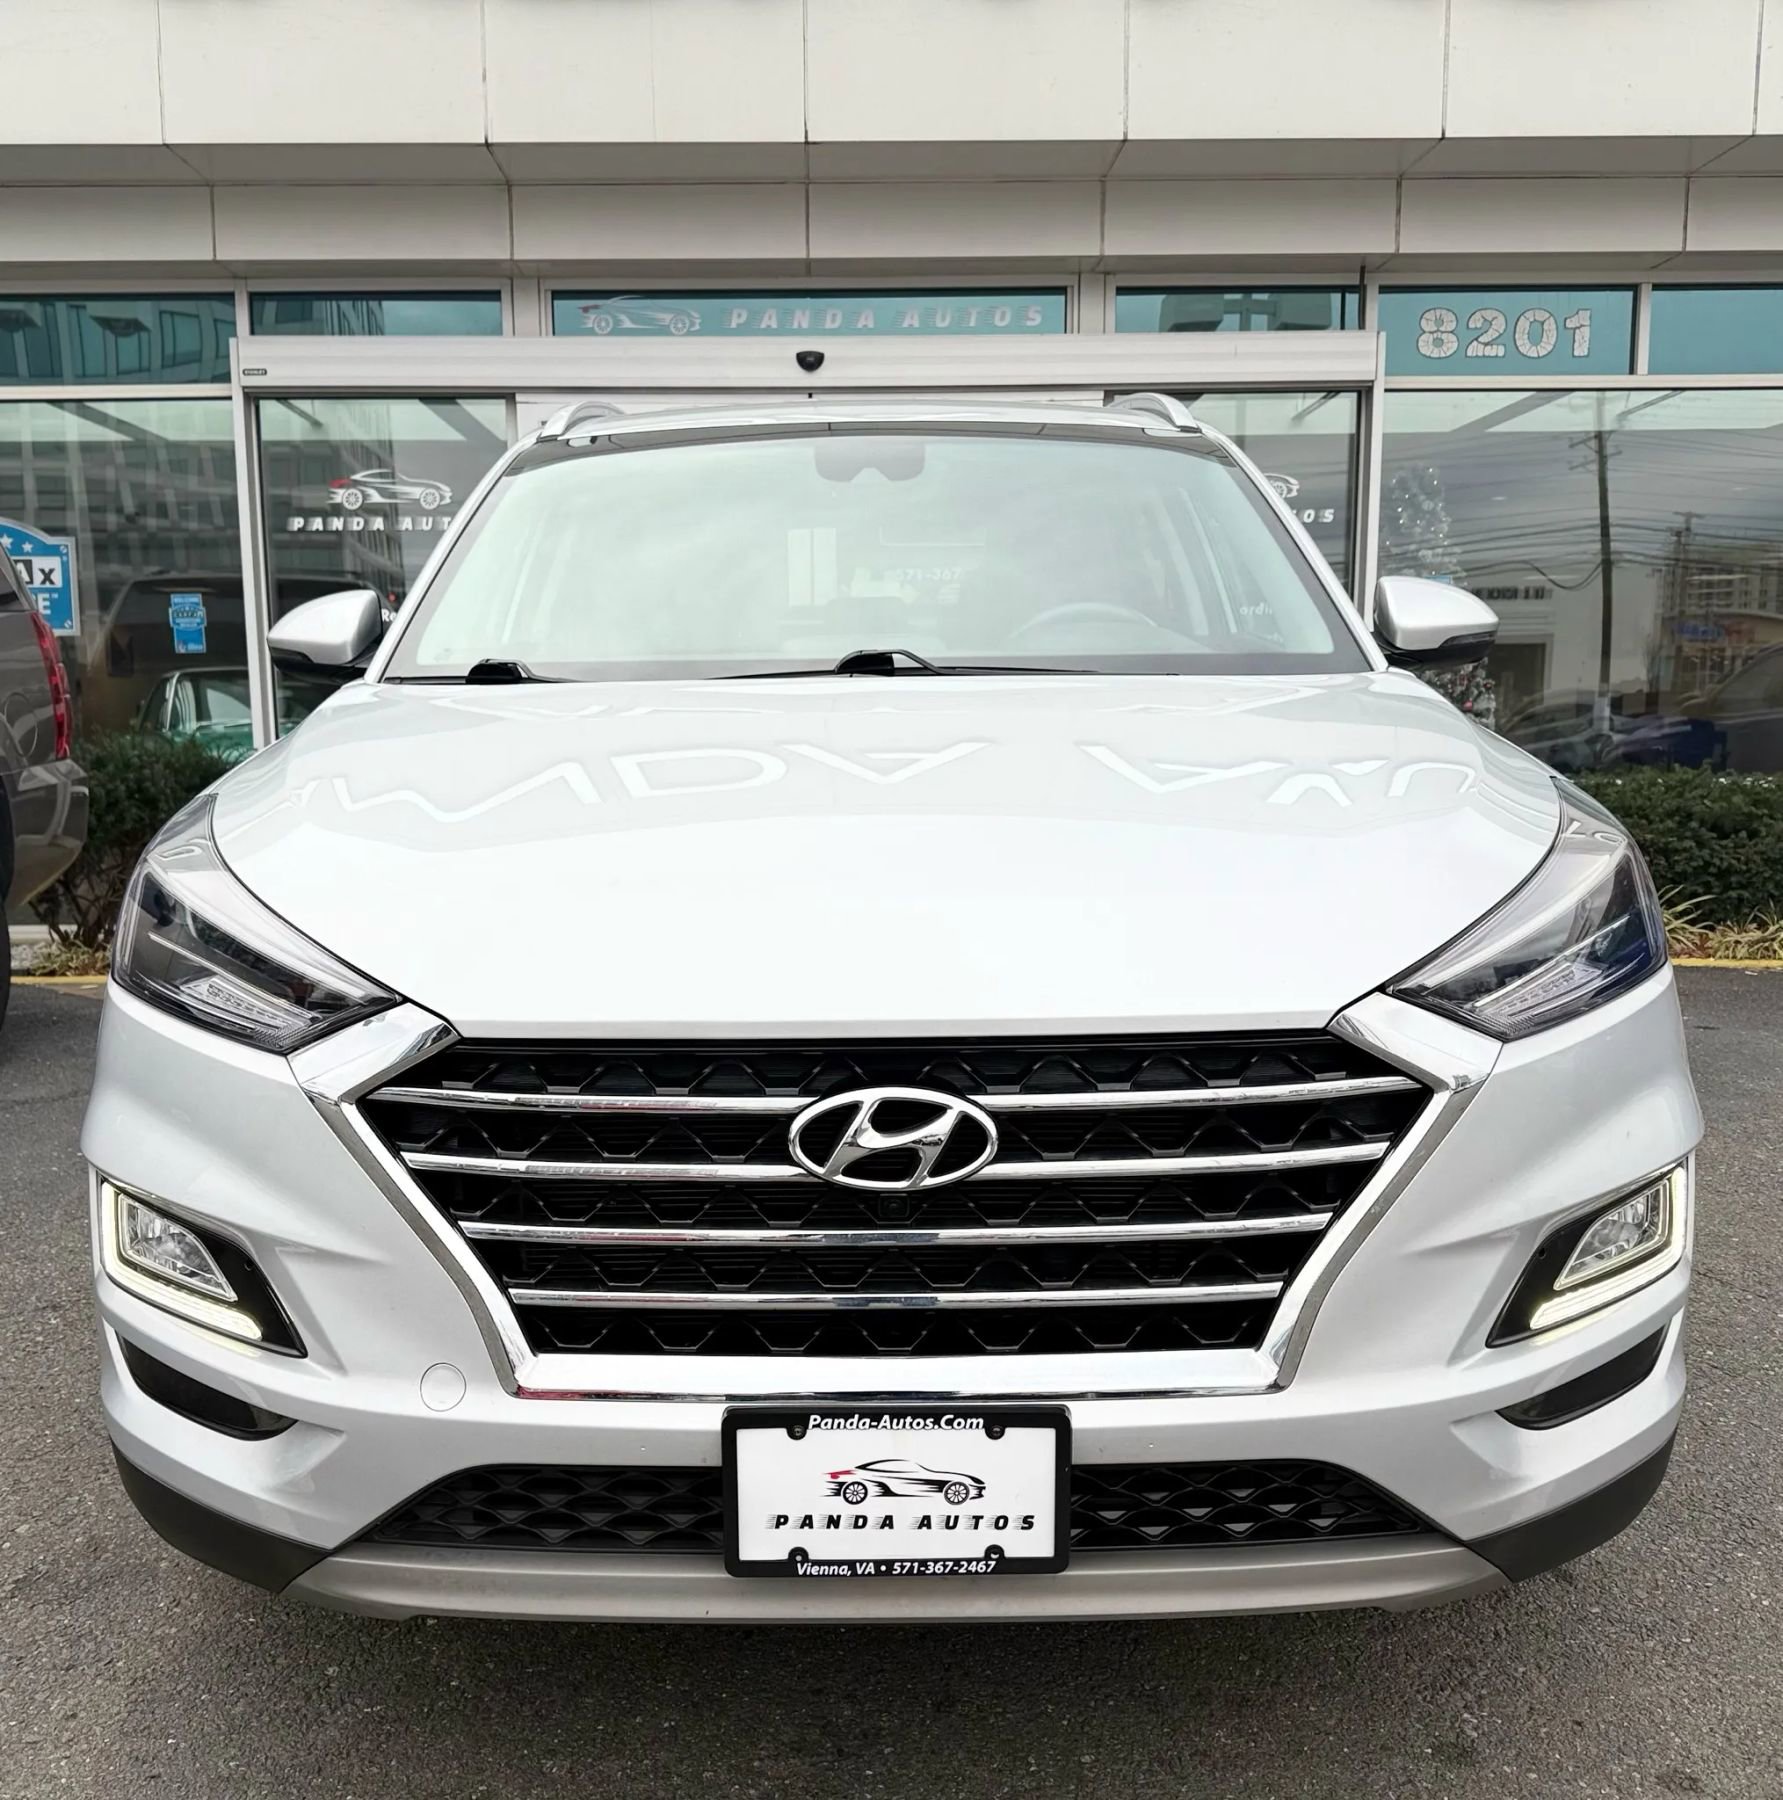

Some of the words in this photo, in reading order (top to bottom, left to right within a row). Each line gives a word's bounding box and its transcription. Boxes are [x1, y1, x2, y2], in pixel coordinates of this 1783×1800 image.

[727, 307, 875, 329] PANDA
[901, 305, 1043, 328] AUTOS
[1416, 307, 1592, 358] 8201
[290, 516, 385, 531] PANDA
[400, 516, 452, 531] AUT
[807, 1414, 985, 1431] Panda-Autos.Com
[770, 1514, 895, 1530] PANDA
[914, 1514, 1036, 1531] AUTOS
[796, 1562, 852, 1577] Vienna,
[856, 1562, 876, 1575] VA
[892, 1560, 997, 1575] 571-367-2467
